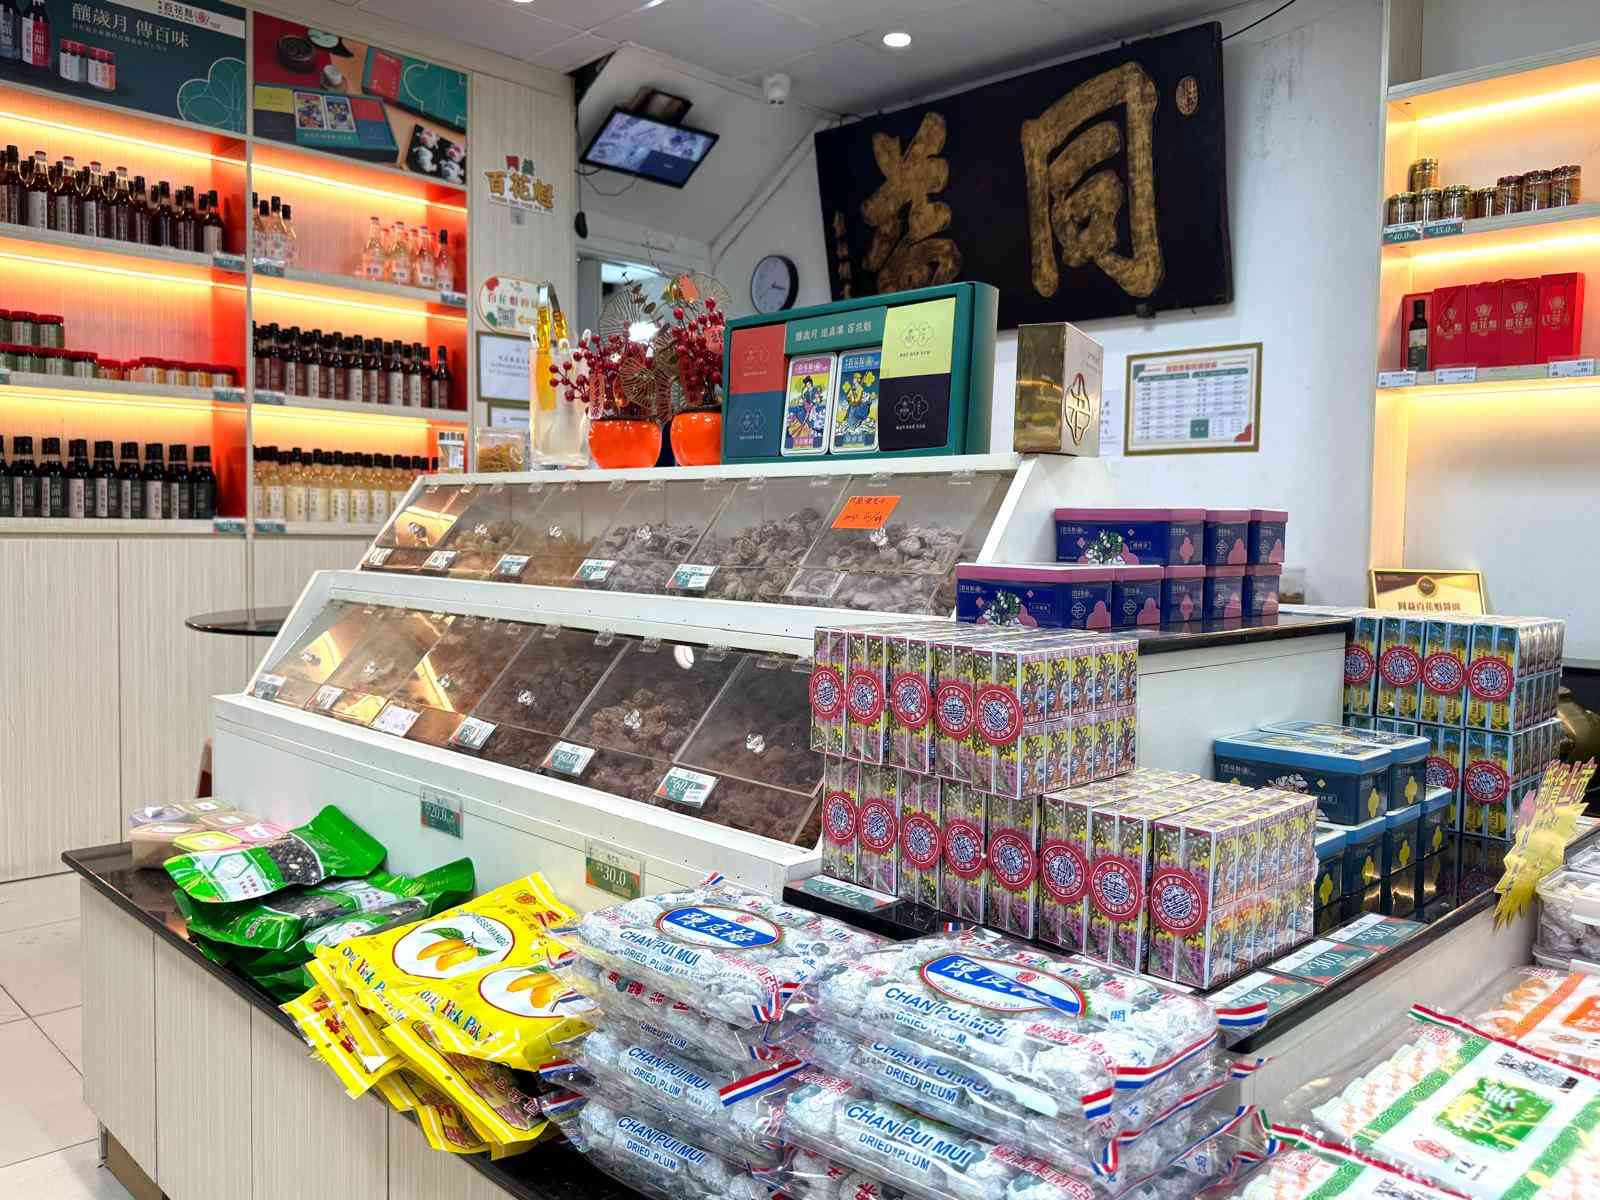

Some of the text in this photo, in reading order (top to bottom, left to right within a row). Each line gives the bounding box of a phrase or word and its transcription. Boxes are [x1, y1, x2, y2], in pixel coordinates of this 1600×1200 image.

[135, 20, 190, 49] 傳百味
[619, 930, 702, 967] CHAN PUI MUI
[623, 946, 674, 975] DRIED PLUM
[884, 986, 935, 1013] CHAN
[462, 1015, 483, 1041] Pak
[628, 1047, 712, 1091] CHAN PUI MUI
[633, 1067, 681, 1097] DRIED PLUM
[885, 1064, 957, 1103] DRIED PLUM
[617, 1117, 706, 1164] CHAN PUI MUI
[847, 1106, 973, 1164] CHAN PUI MUI
[858, 1132, 930, 1171] DRIED PLUM
[626, 1140, 677, 1170] DRIED PLUM
